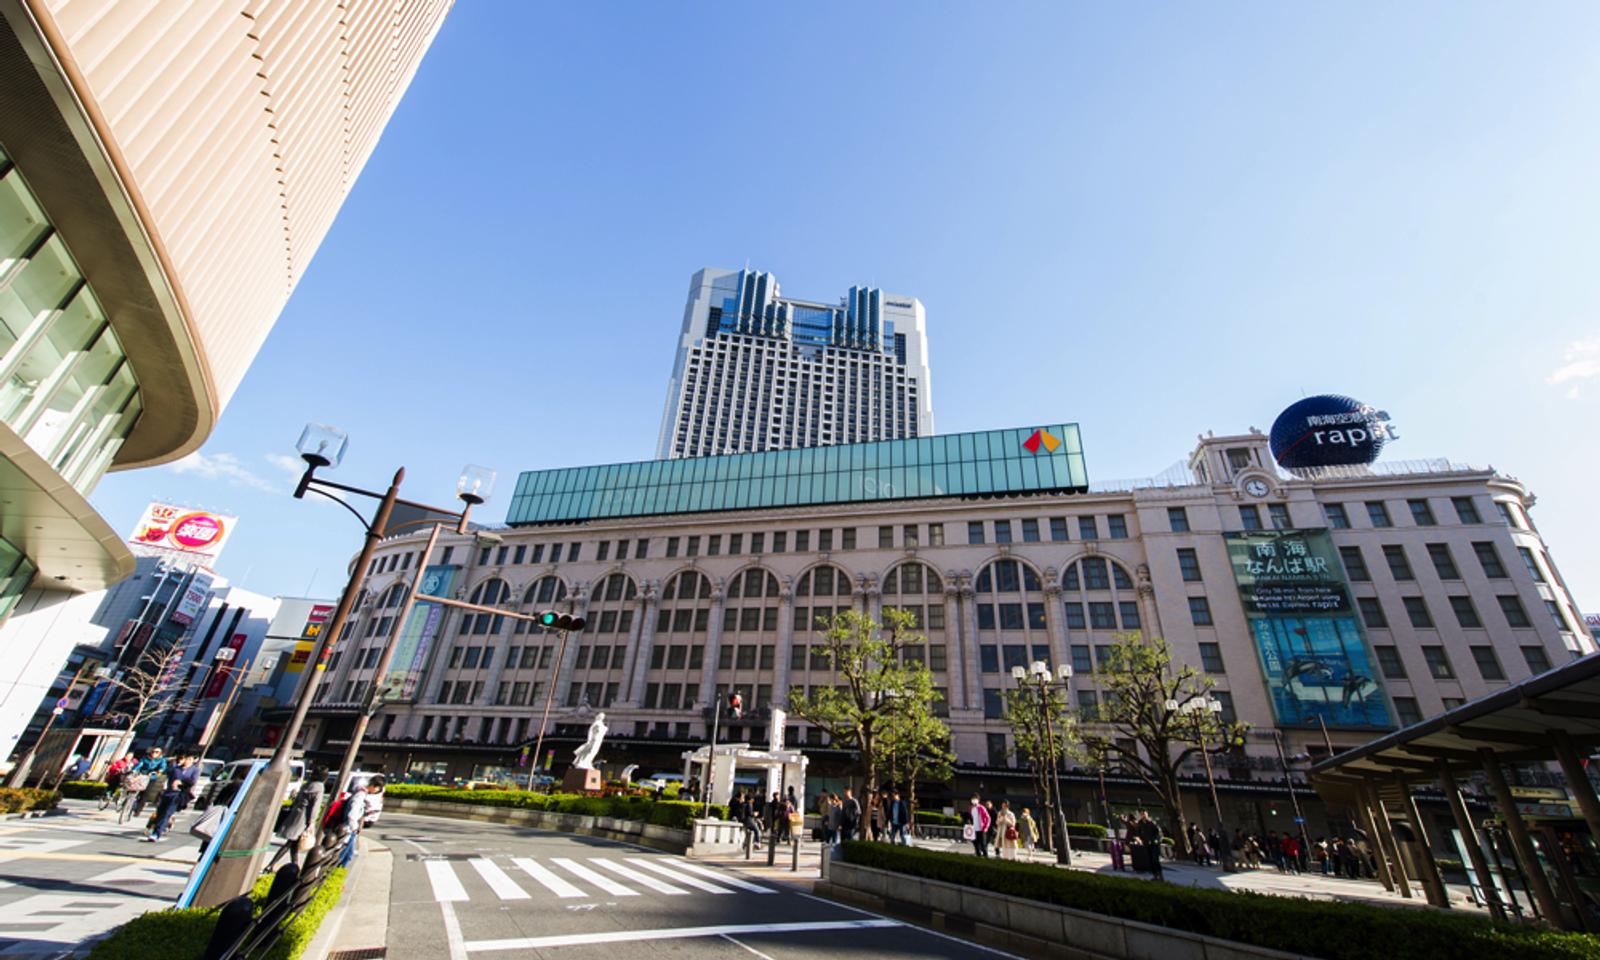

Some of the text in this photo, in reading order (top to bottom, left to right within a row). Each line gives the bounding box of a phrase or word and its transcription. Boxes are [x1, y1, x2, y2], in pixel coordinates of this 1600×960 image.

[1256, 540, 1307, 557] 南海
[1245, 556, 1329, 575] なんば駅
